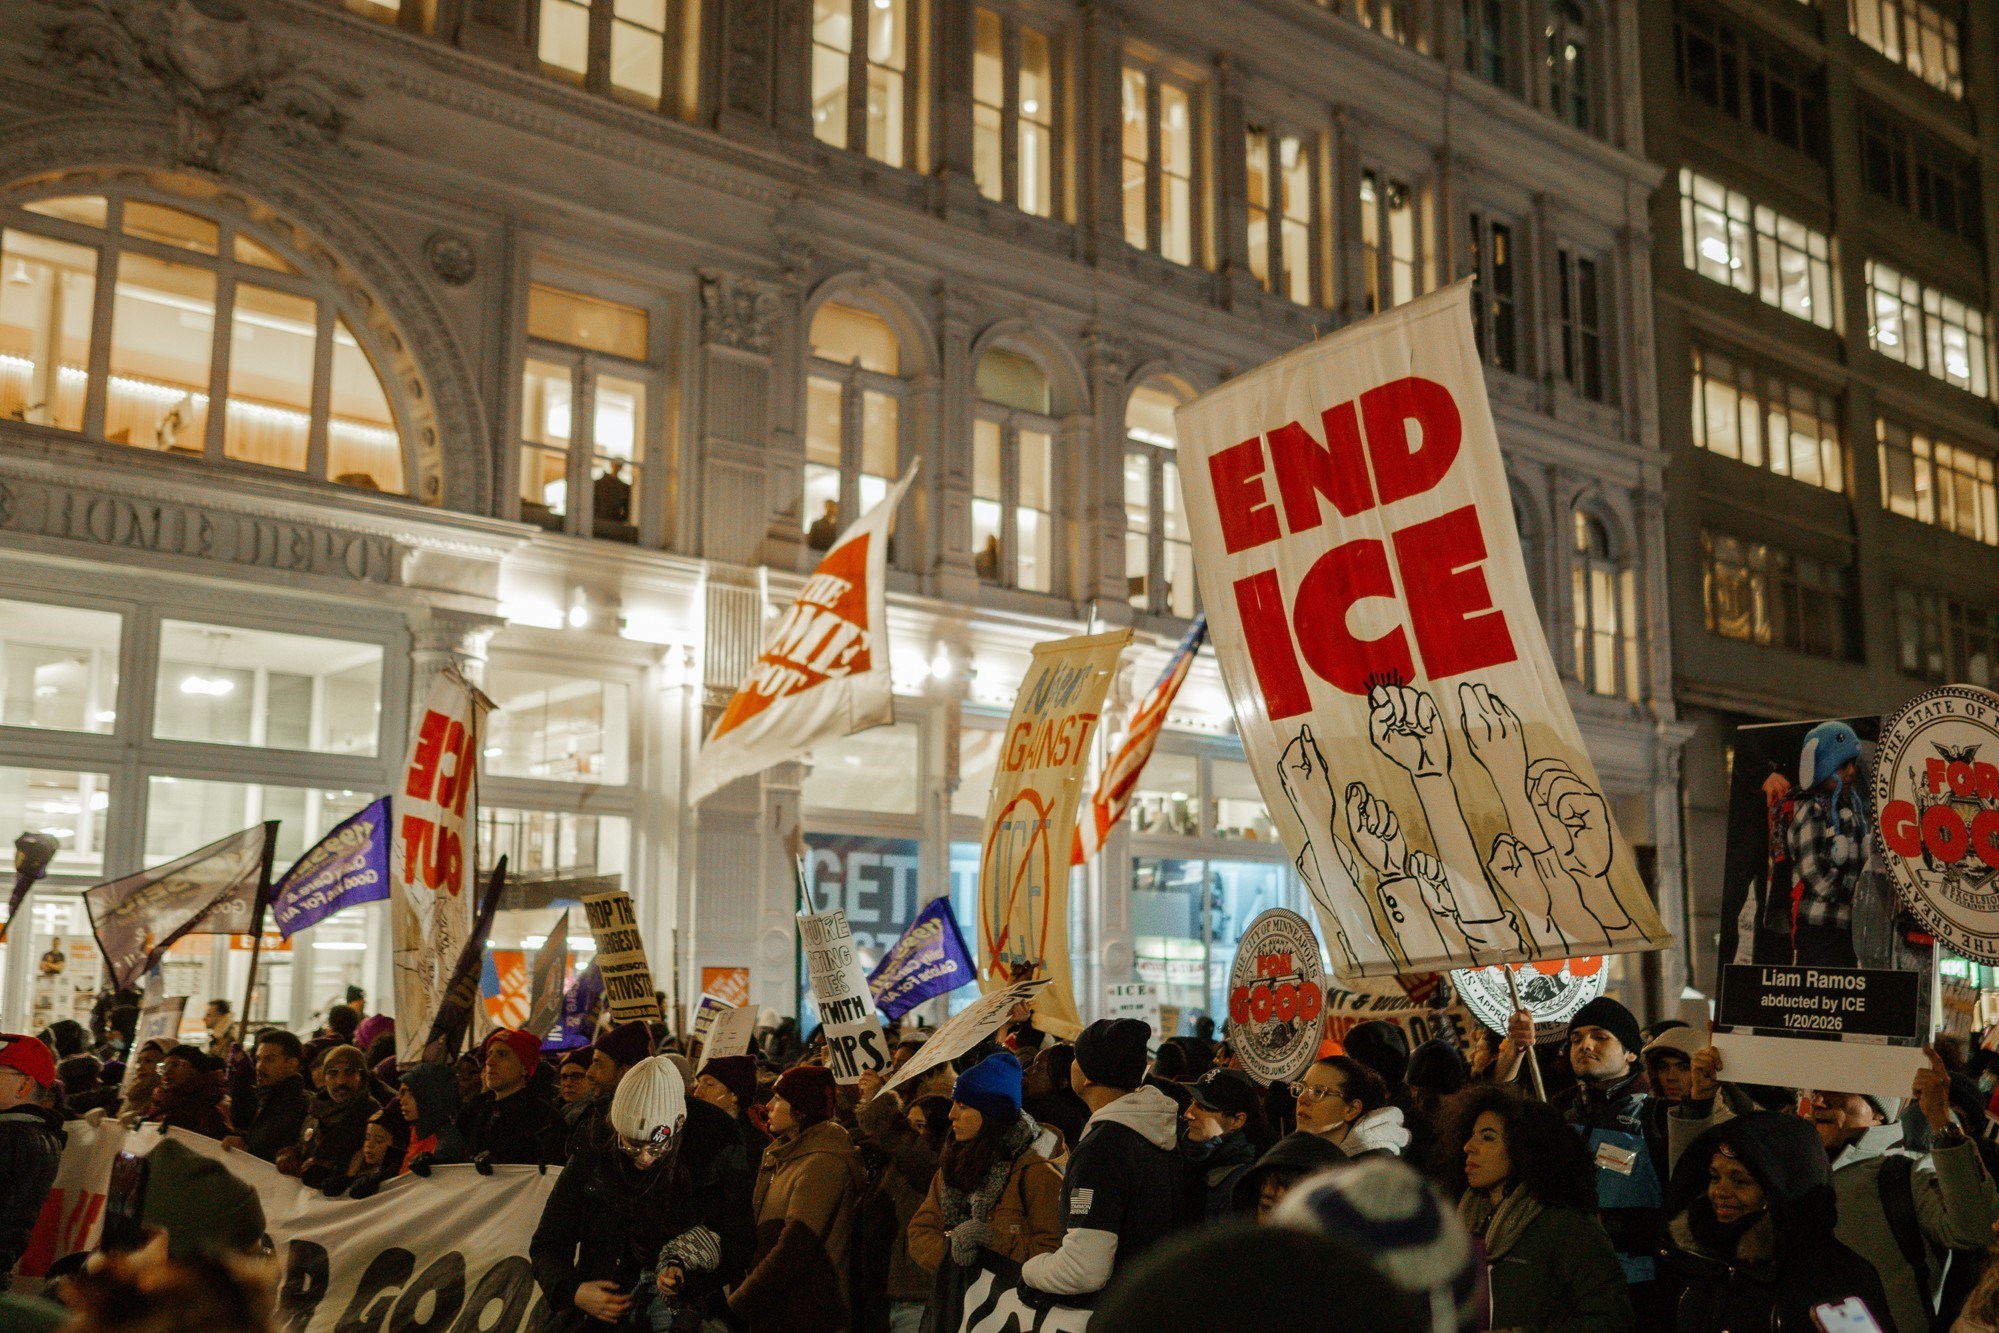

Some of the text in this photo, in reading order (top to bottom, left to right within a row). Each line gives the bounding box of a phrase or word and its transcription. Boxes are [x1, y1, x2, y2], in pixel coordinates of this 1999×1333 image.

[1208, 376, 1462, 555] END
[42, 488, 216, 559] HOME
[233, 515, 393, 583] DEPOT
[1233, 504, 1518, 722] ICE
[1879, 701, 1986, 799] OF THE STATE OF
[1925, 757, 1999, 799] FOR
[1880, 799, 1999, 870] GOO
[812, 848, 918, 925] GET
[1950, 886, 1999, 905] EXCELSIO
[1903, 882, 1997, 954] THE GREAT
[1235, 919, 1318, 979] THE CITY OF MINNEAPOLIS
[1257, 952, 1292, 978] FOR
[1117, 985, 1147, 996] ICE
[1762, 969, 1866, 991] Liam Ramos
[828, 996, 866, 1024] WITH
[1230, 981, 1321, 1024] GOOD
[1476, 995, 1587, 1031] APPRO UNE 5TH 1878
[1761, 994, 1865, 1013] abducted by ICE
[1783, 1013, 1843, 1031] 1/20/2026
[1241, 1044, 1270, 1075] APPROVED
[1270, 1064, 1286, 1076] JUNE
[1296, 1042, 1309, 1062] 1878
[653, 1133, 667, 1142] NY
